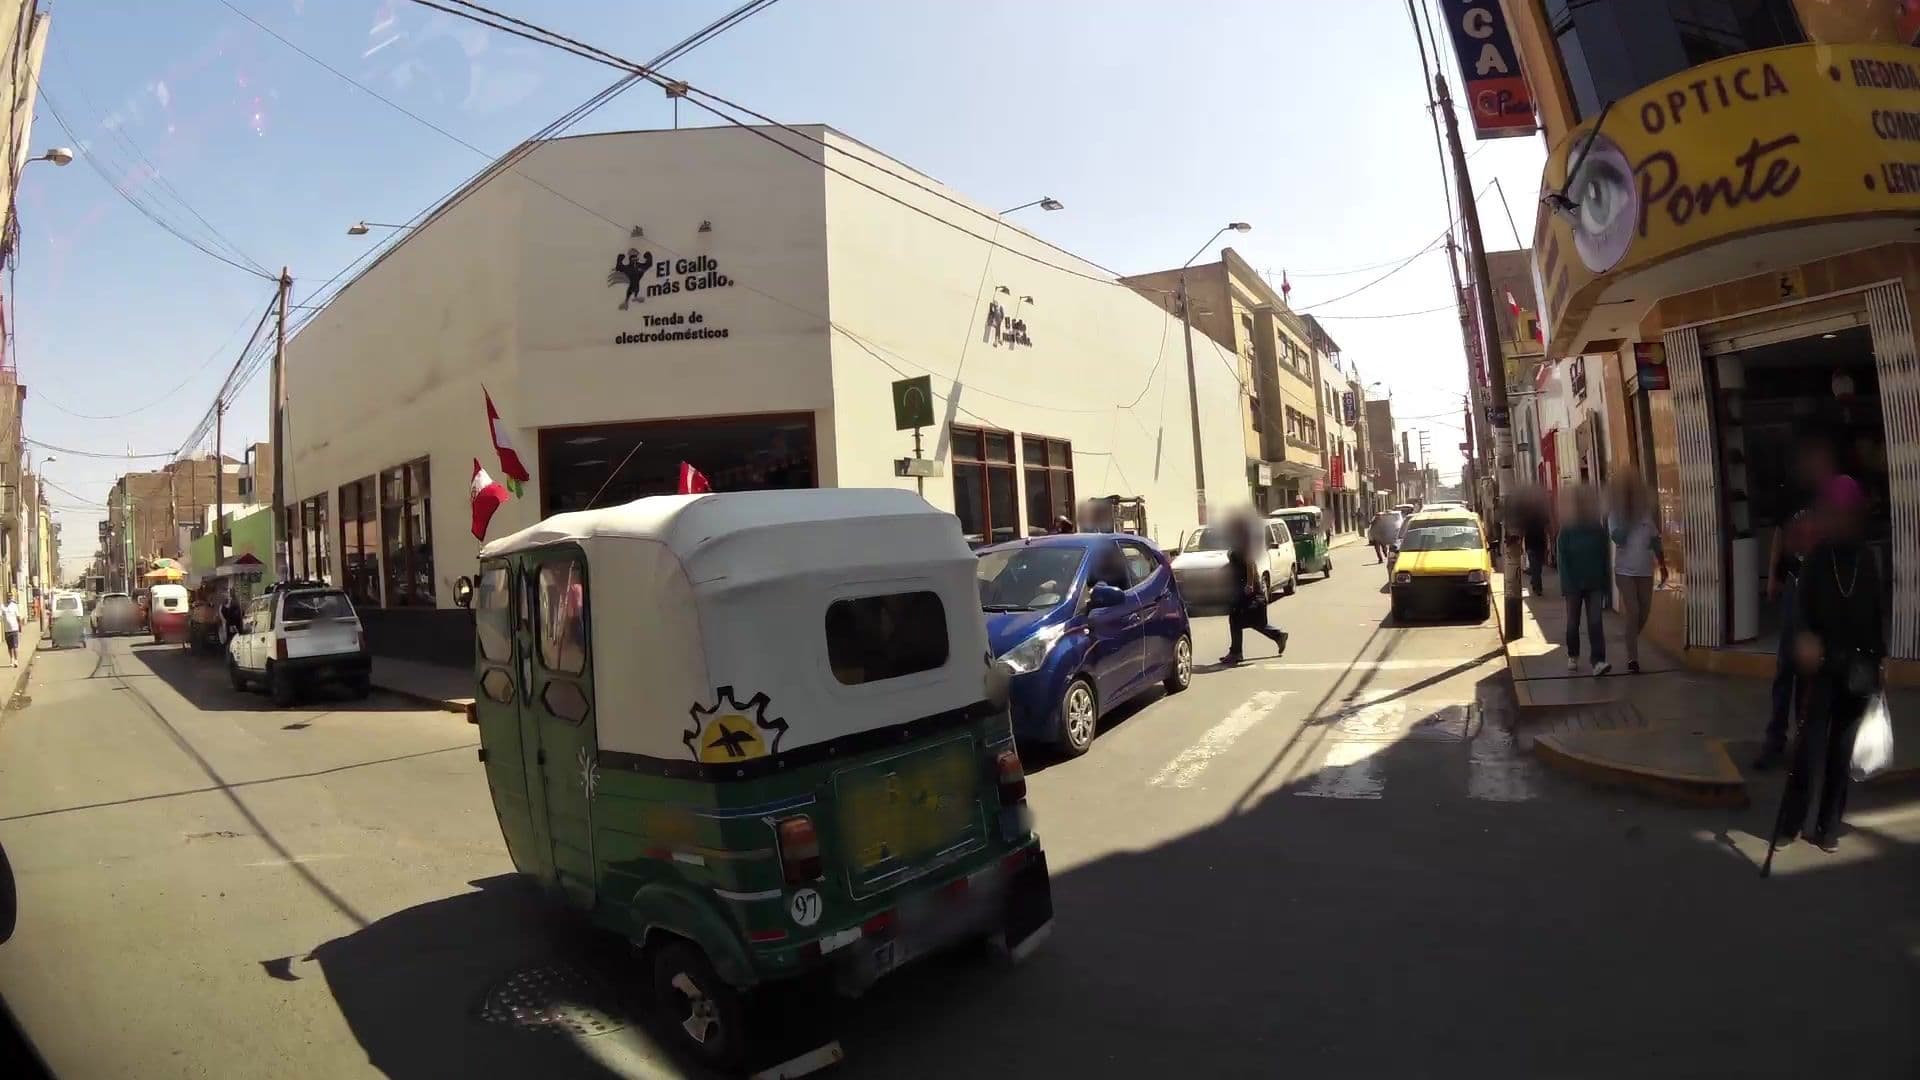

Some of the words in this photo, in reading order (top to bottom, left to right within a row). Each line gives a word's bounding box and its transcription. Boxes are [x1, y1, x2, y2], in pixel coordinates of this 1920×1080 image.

[1463, 0, 1508, 75] CA
[1640, 63, 1789, 134] OPTICA
[1634, 133, 1801, 237] Ponte
[656, 260, 670, 278] El
[675, 255, 718, 275] Gallo
[646, 279, 680, 297] más
[643, 312, 684, 327] Tienda
[688, 311, 703, 323] de
[615, 327, 729, 344] electrodomésticos
[794, 893, 817, 921] 97
